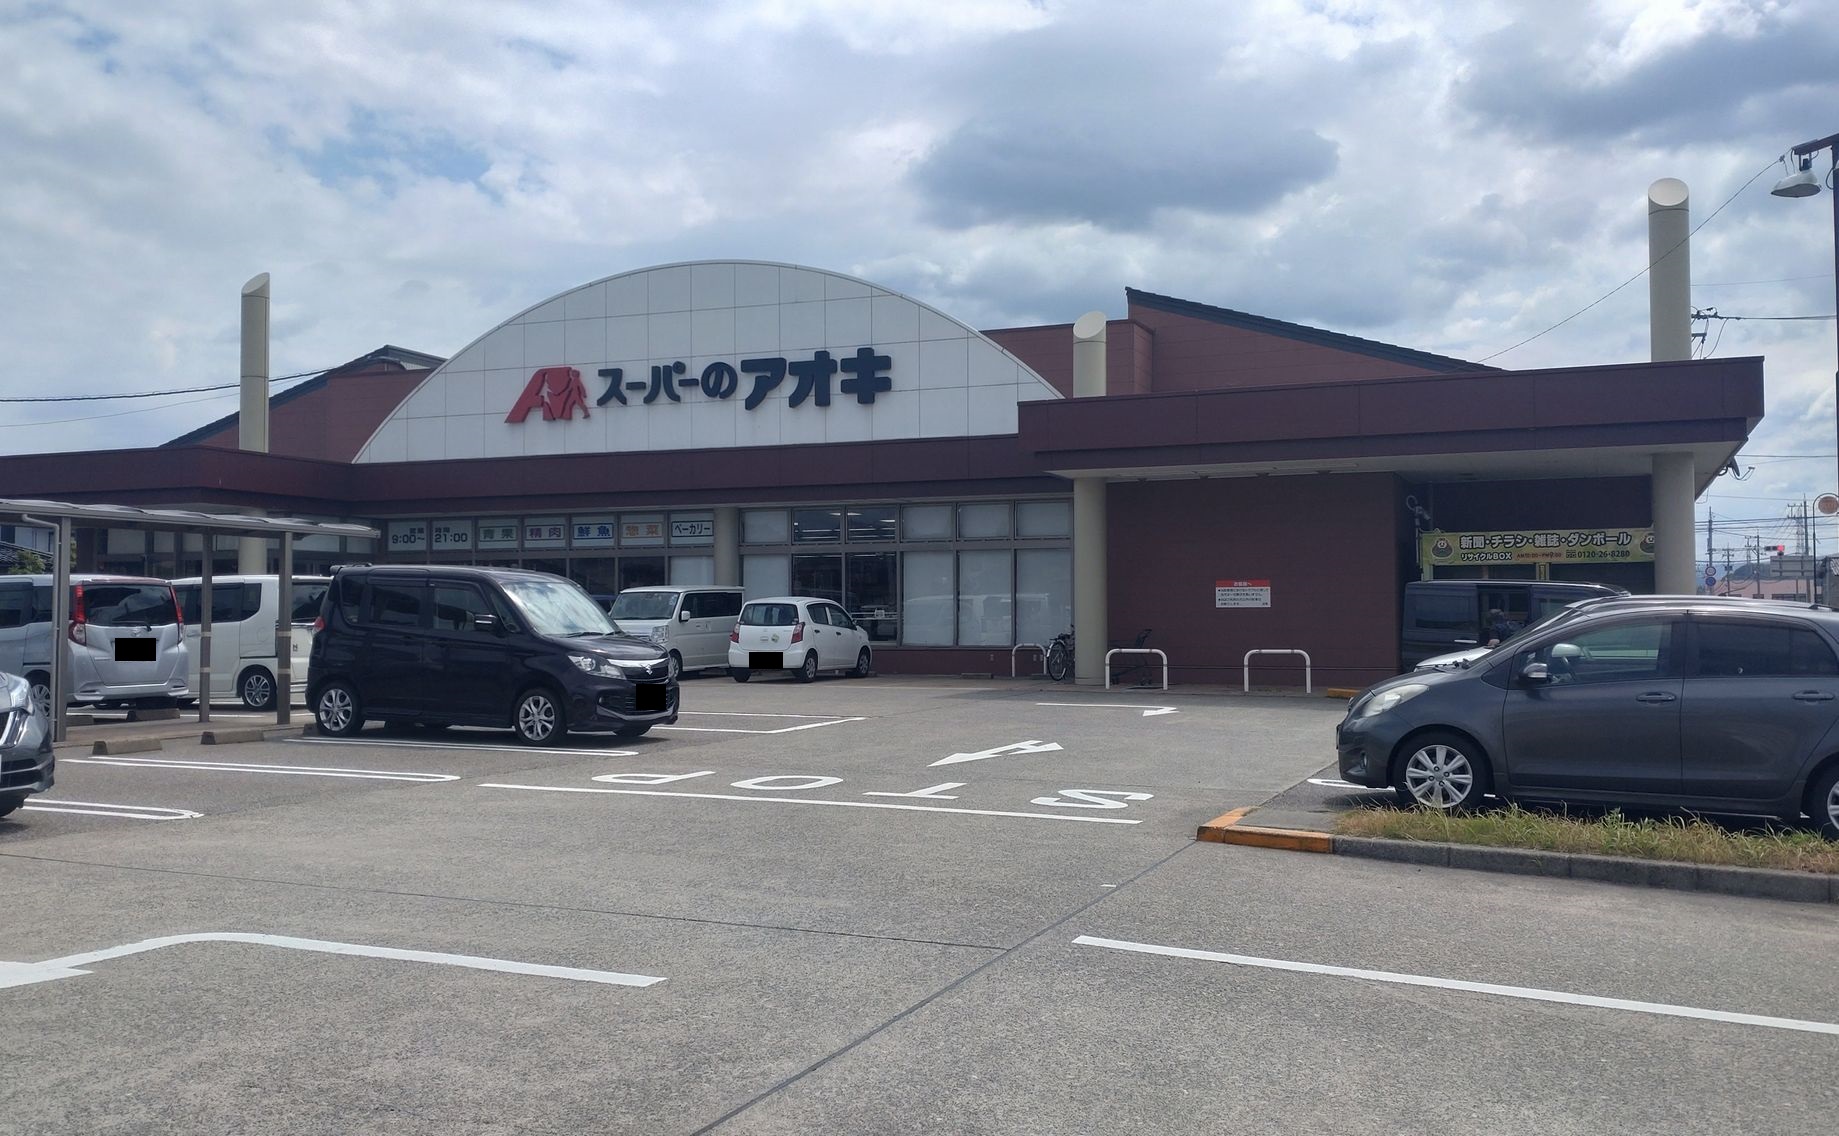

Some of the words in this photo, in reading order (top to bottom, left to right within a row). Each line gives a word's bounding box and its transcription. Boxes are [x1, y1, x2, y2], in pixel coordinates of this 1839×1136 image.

[597, 347, 893, 411] スーパーのアオキ
[483, 528, 513, 539] 青果
[529, 527, 561, 539] 精肉
[577, 525, 611, 537] 鮮魚
[674, 523, 711, 535] ベーカリー
[434, 533, 468, 543] 21:00
[1461, 551, 1513, 561] リサイクルBOX
[591, 770, 1154, 810] STOP
